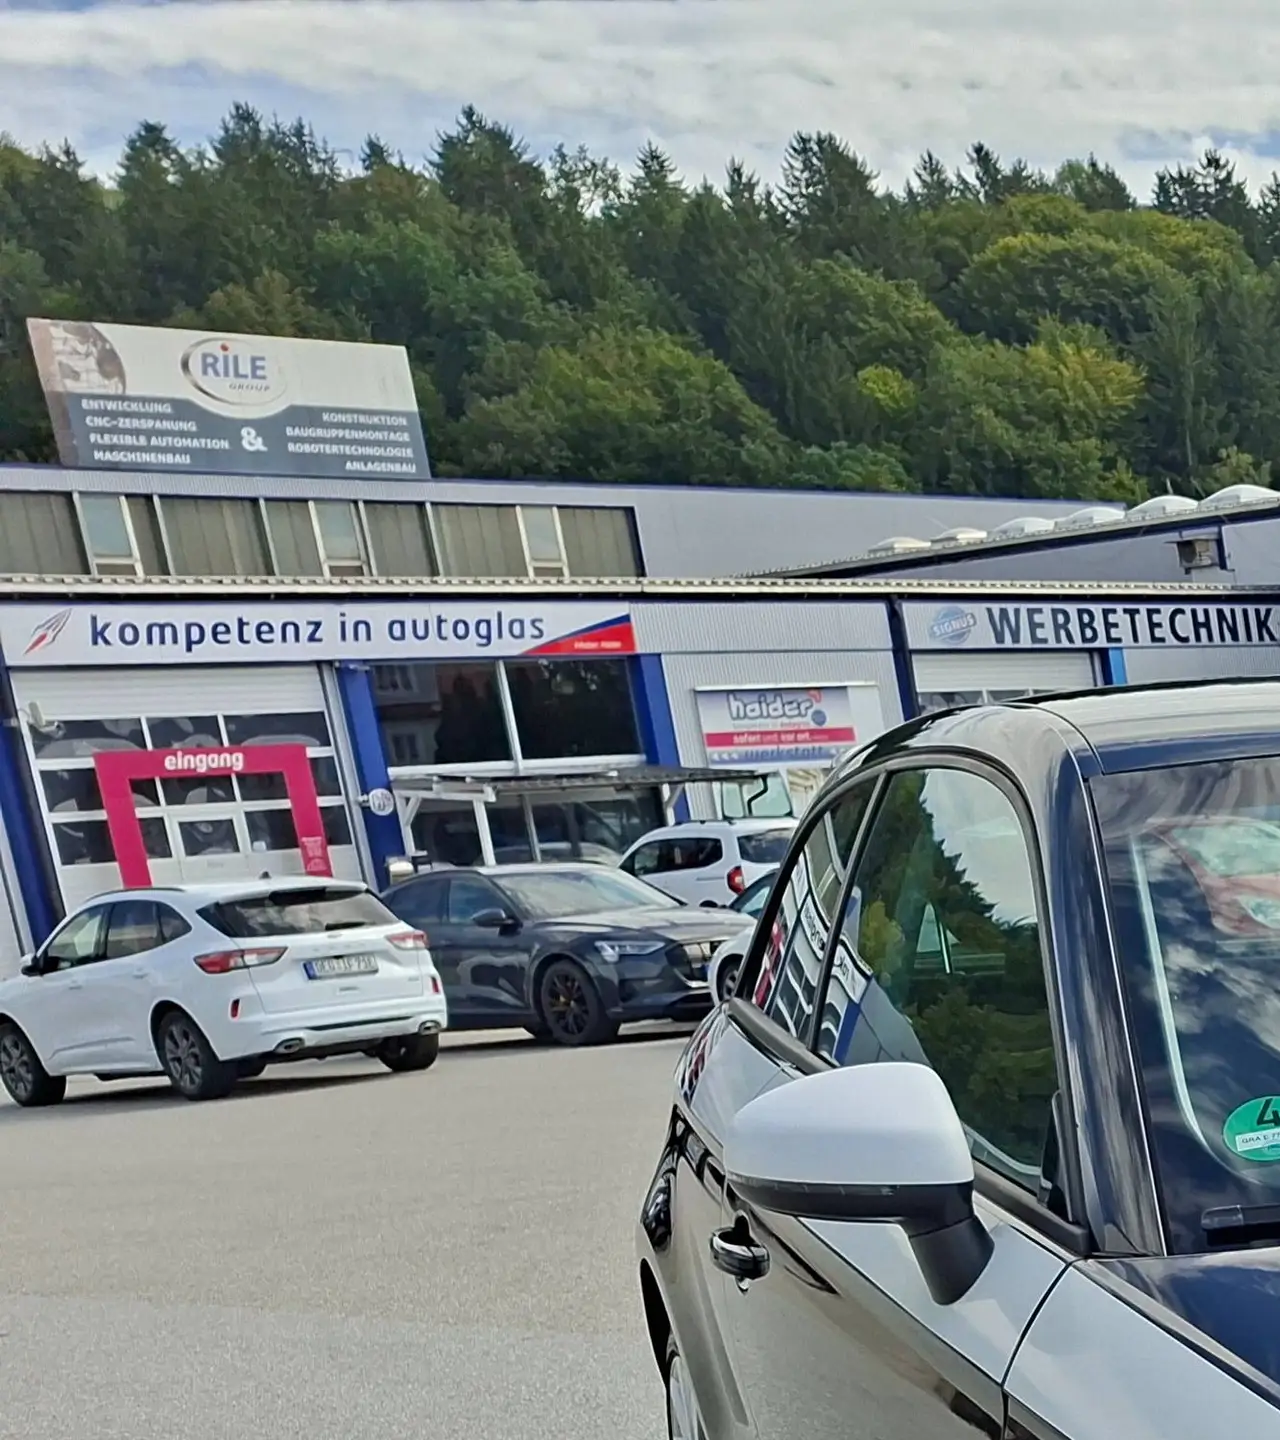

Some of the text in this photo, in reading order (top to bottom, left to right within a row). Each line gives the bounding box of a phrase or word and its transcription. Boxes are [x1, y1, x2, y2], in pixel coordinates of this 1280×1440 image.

[81, 399, 173, 413] ENTWICKLUNG
[322, 412, 408, 426] KONSTRUKTION
[89, 433, 230, 450] FLEXIBLE AUTOMATION
[240, 426, 269, 451] &
[286, 426, 411, 441] BAUGRUPPENMONTAGE
[93, 450, 191, 464] MASCHINENBAU
[345, 460, 417, 474] ANLAGENBAU
[90, 611, 545, 653] kompetenz in autoglas
[932, 613, 977, 636] SIGNUS
[986, 607, 1278, 645] WERBETECHNIK
[727, 692, 814, 721] haider
[164, 751, 244, 772] eingang
